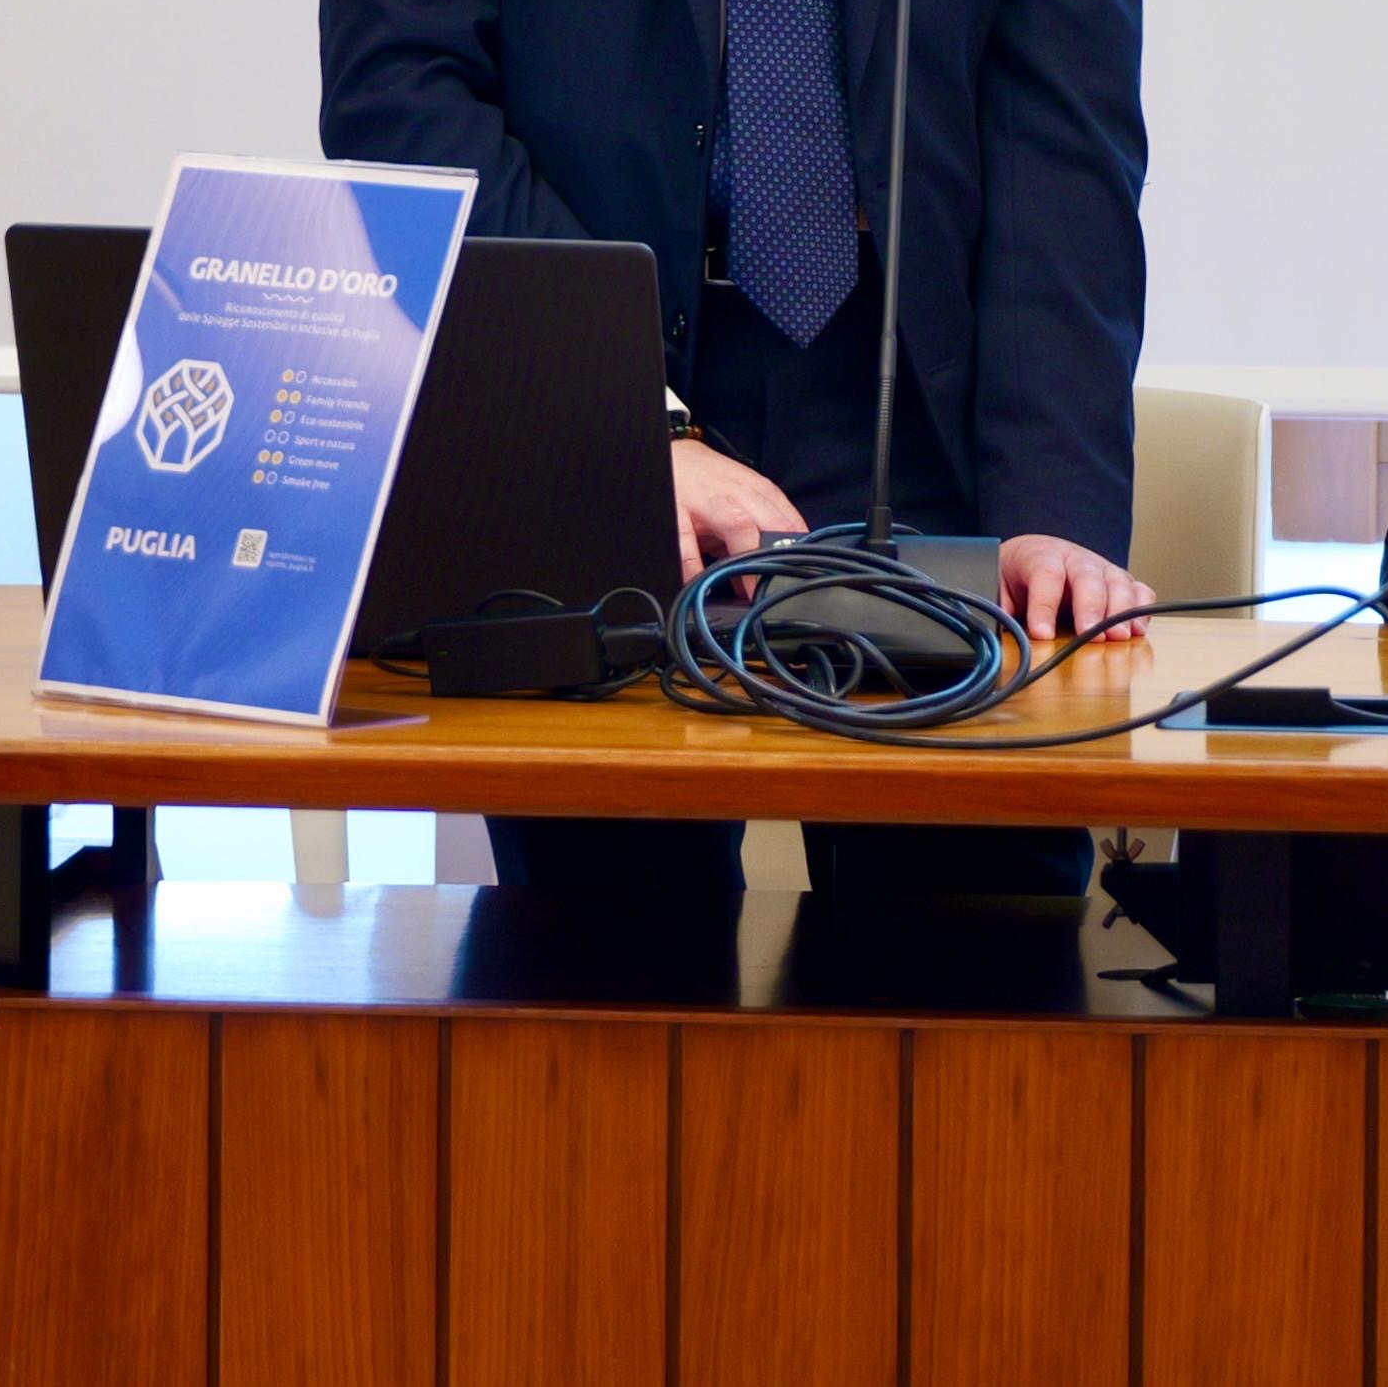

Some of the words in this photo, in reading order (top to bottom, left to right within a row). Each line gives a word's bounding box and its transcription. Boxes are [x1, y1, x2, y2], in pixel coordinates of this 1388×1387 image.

[189, 256, 316, 290] GRANELLO
[318, 268, 399, 298] D'ORO
[104, 526, 196, 561] PUGLIA
